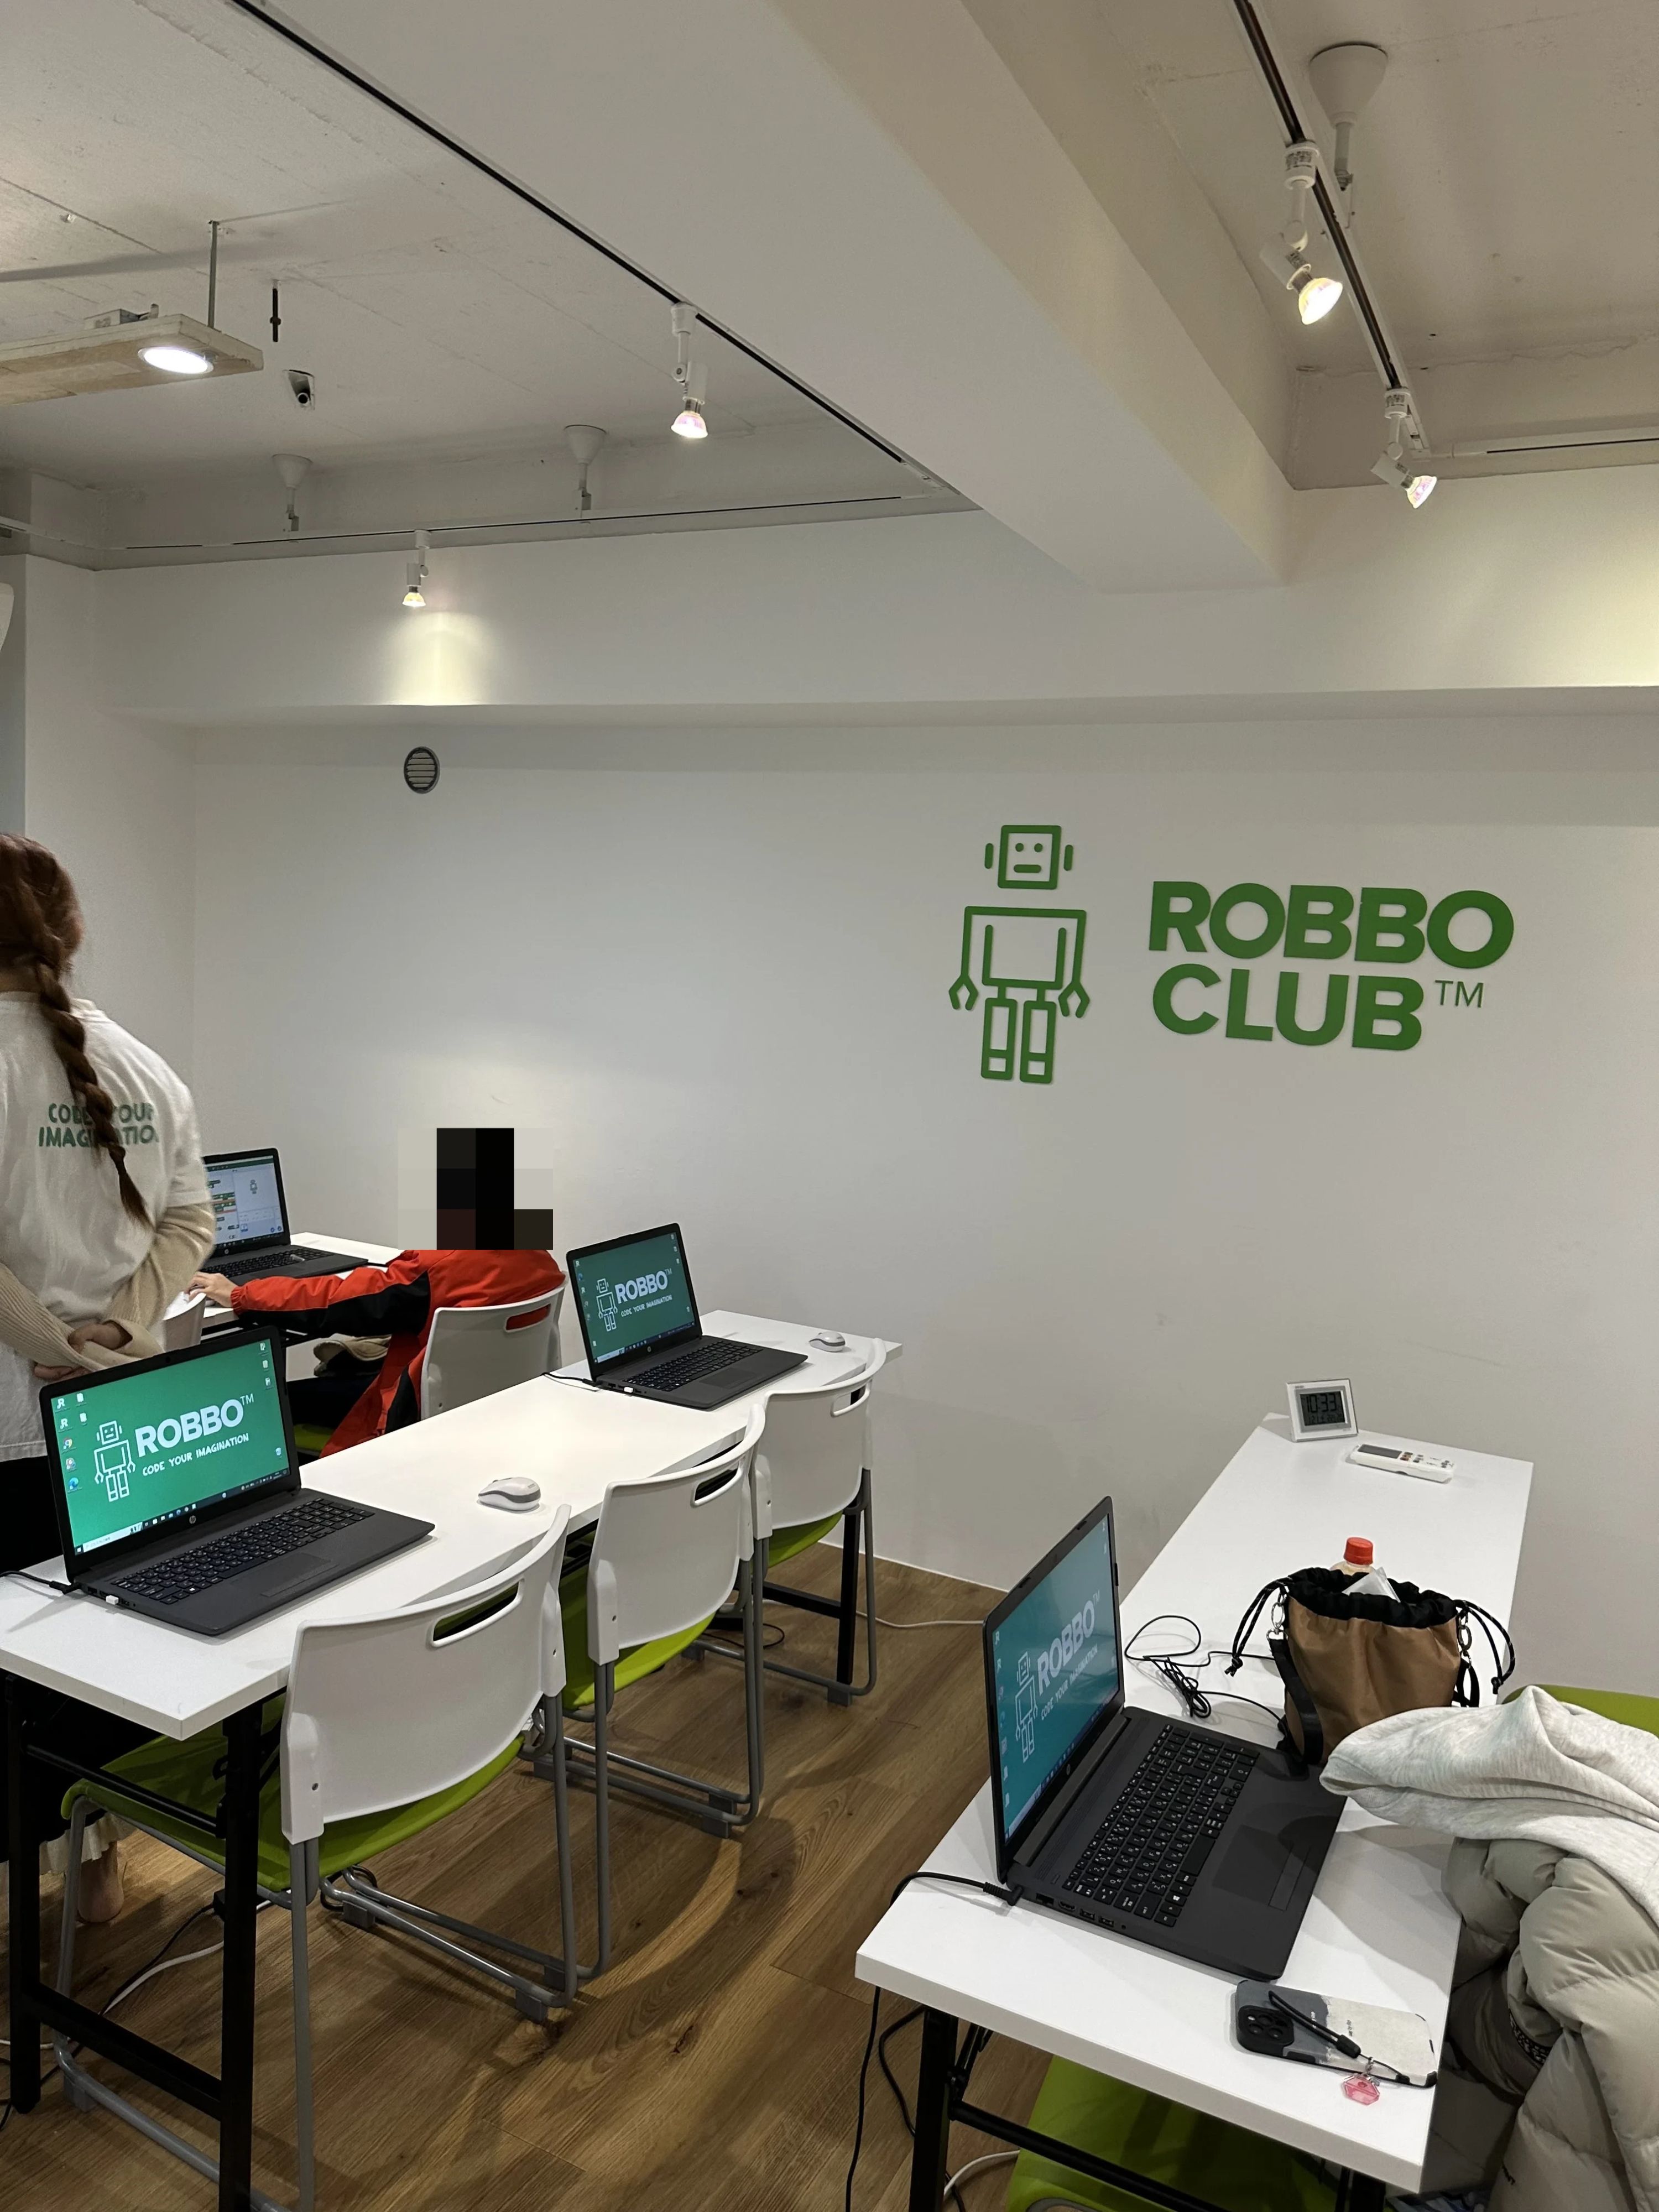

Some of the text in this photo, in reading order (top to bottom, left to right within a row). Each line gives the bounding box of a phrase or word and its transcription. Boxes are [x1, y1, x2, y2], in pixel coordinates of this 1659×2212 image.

[1149, 881, 1514, 969] ROBBO
[1152, 963, 1424, 1051] CLUB
[614, 1270, 668, 1305] ROBBO
[620, 1308, 633, 1317] CODE
[633, 1303, 646, 1313] YOUR
[134, 1399, 244, 1458] ROBBO
[142, 1432, 249, 1477] CODE YOUR IMAGINATION
[1037, 1600, 1095, 1696] ROBBO
[1041, 1697, 1054, 1721] CODE
[1055, 1679, 1069, 1703] YOUR
